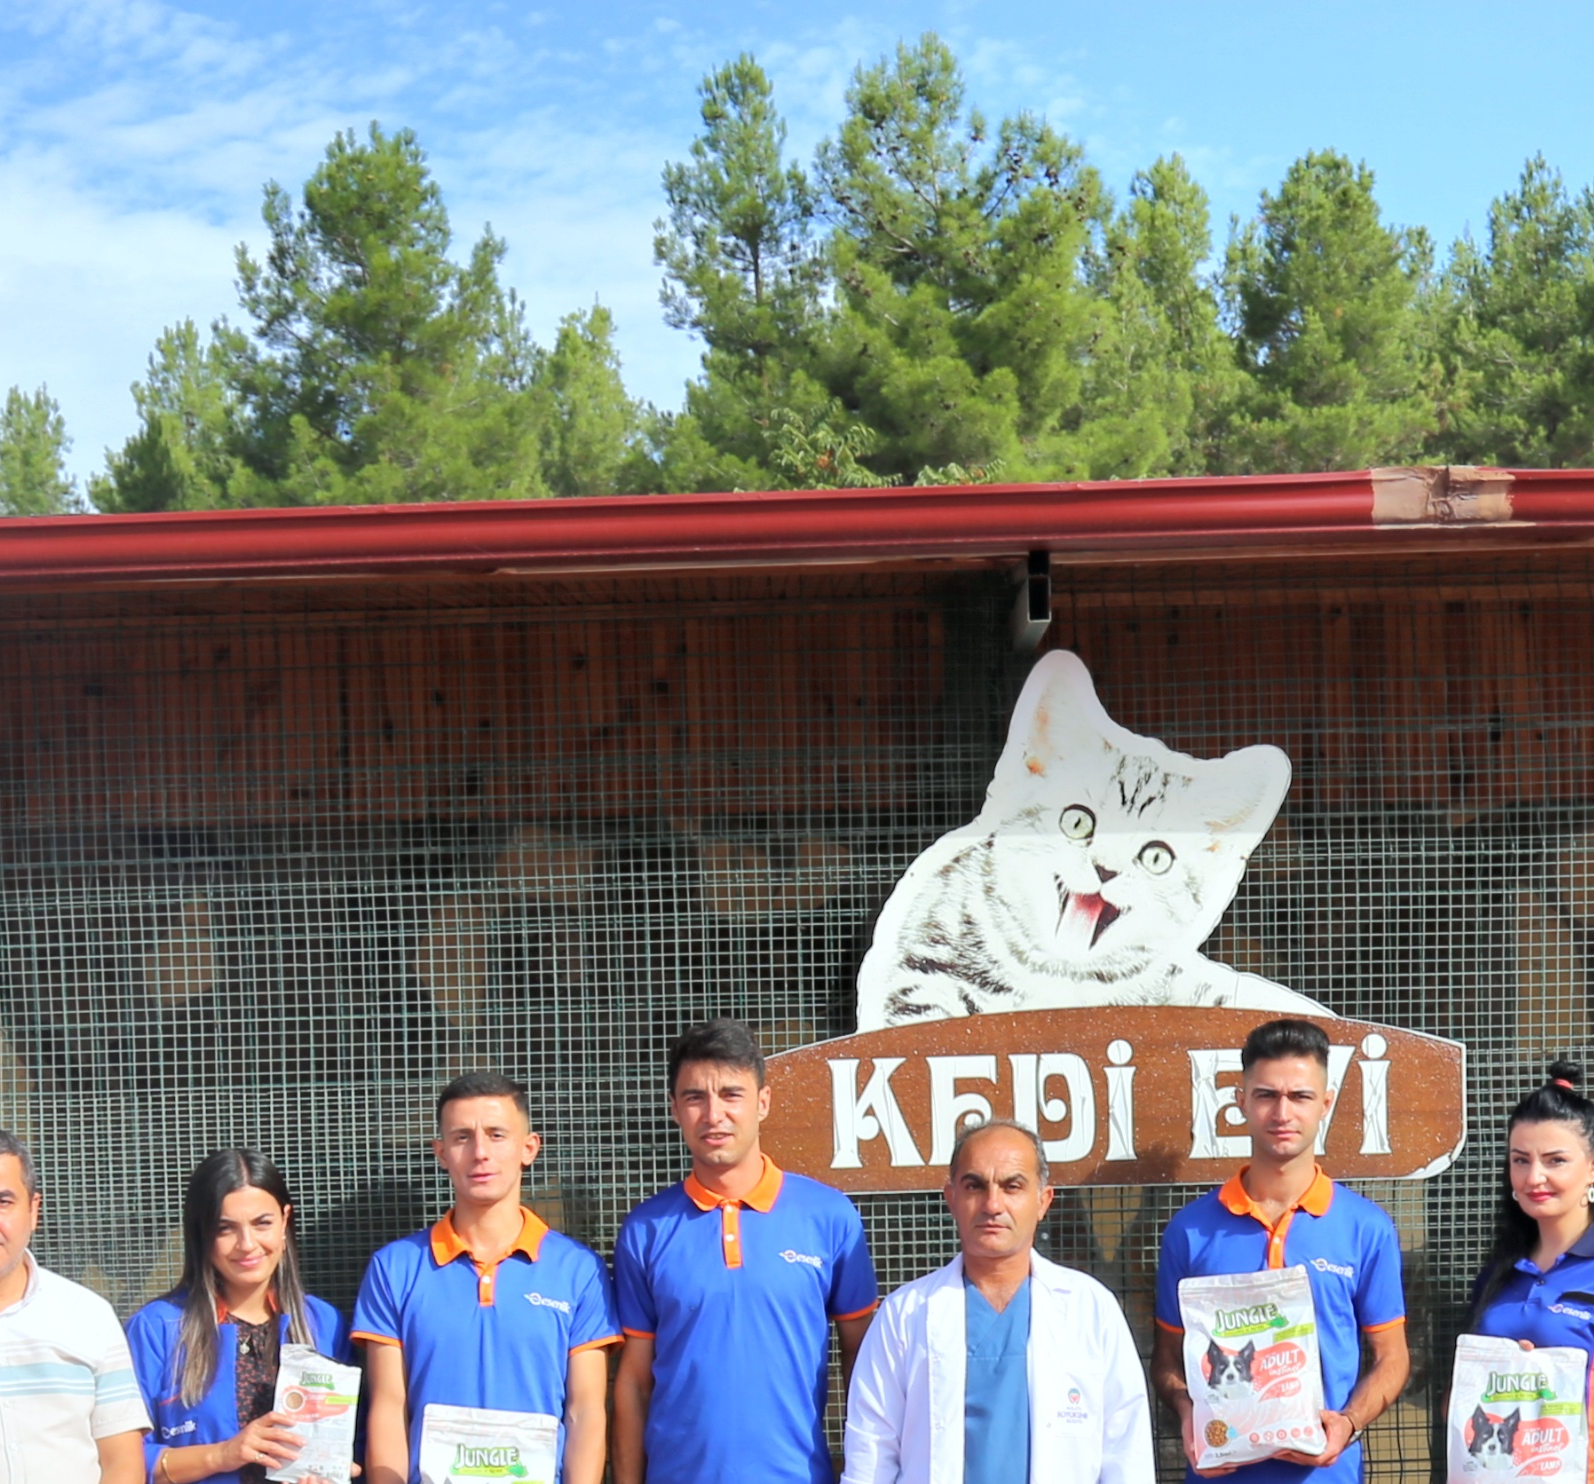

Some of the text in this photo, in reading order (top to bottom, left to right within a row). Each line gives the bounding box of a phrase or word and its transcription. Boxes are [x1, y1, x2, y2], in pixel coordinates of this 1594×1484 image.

[1214, 1304, 1277, 1333] JUNGLE
[1259, 1348, 1301, 1372] ADULT
[1486, 1371, 1548, 1397] JUNGLE
[1521, 1427, 1566, 1446] ADULT
[453, 1442, 520, 1470] JUNGLE
